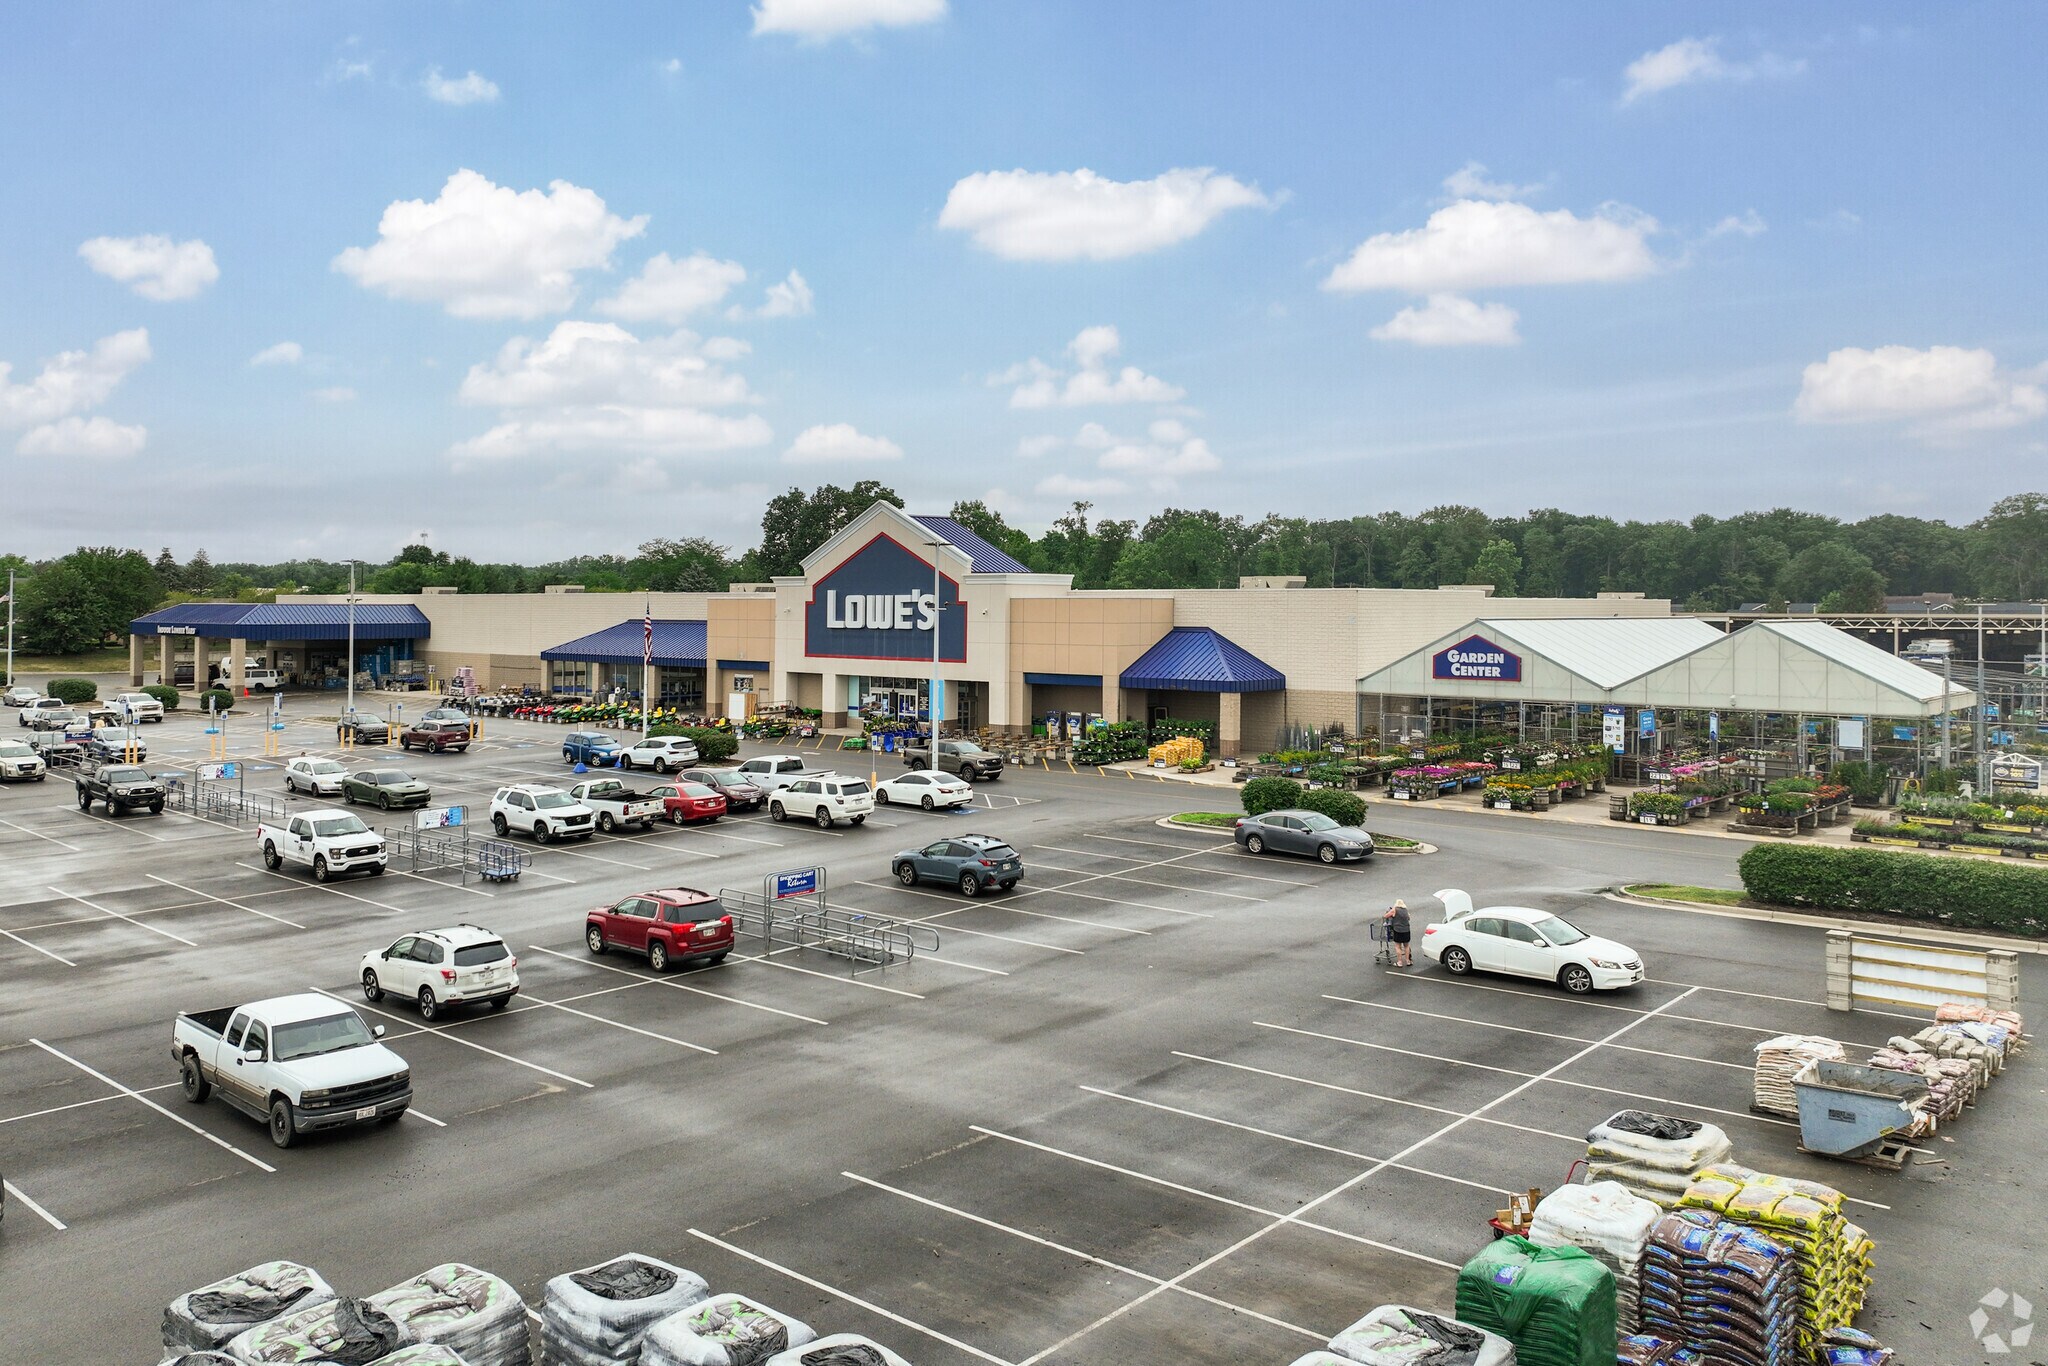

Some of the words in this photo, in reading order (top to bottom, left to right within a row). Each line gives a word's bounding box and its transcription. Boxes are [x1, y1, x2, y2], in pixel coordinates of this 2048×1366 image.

[826, 589, 937, 630] LOWE'S
[1447, 649, 1504, 664] GARDEN
[1450, 663, 1501, 677] CENTER
[787, 879, 807, 887] Return
